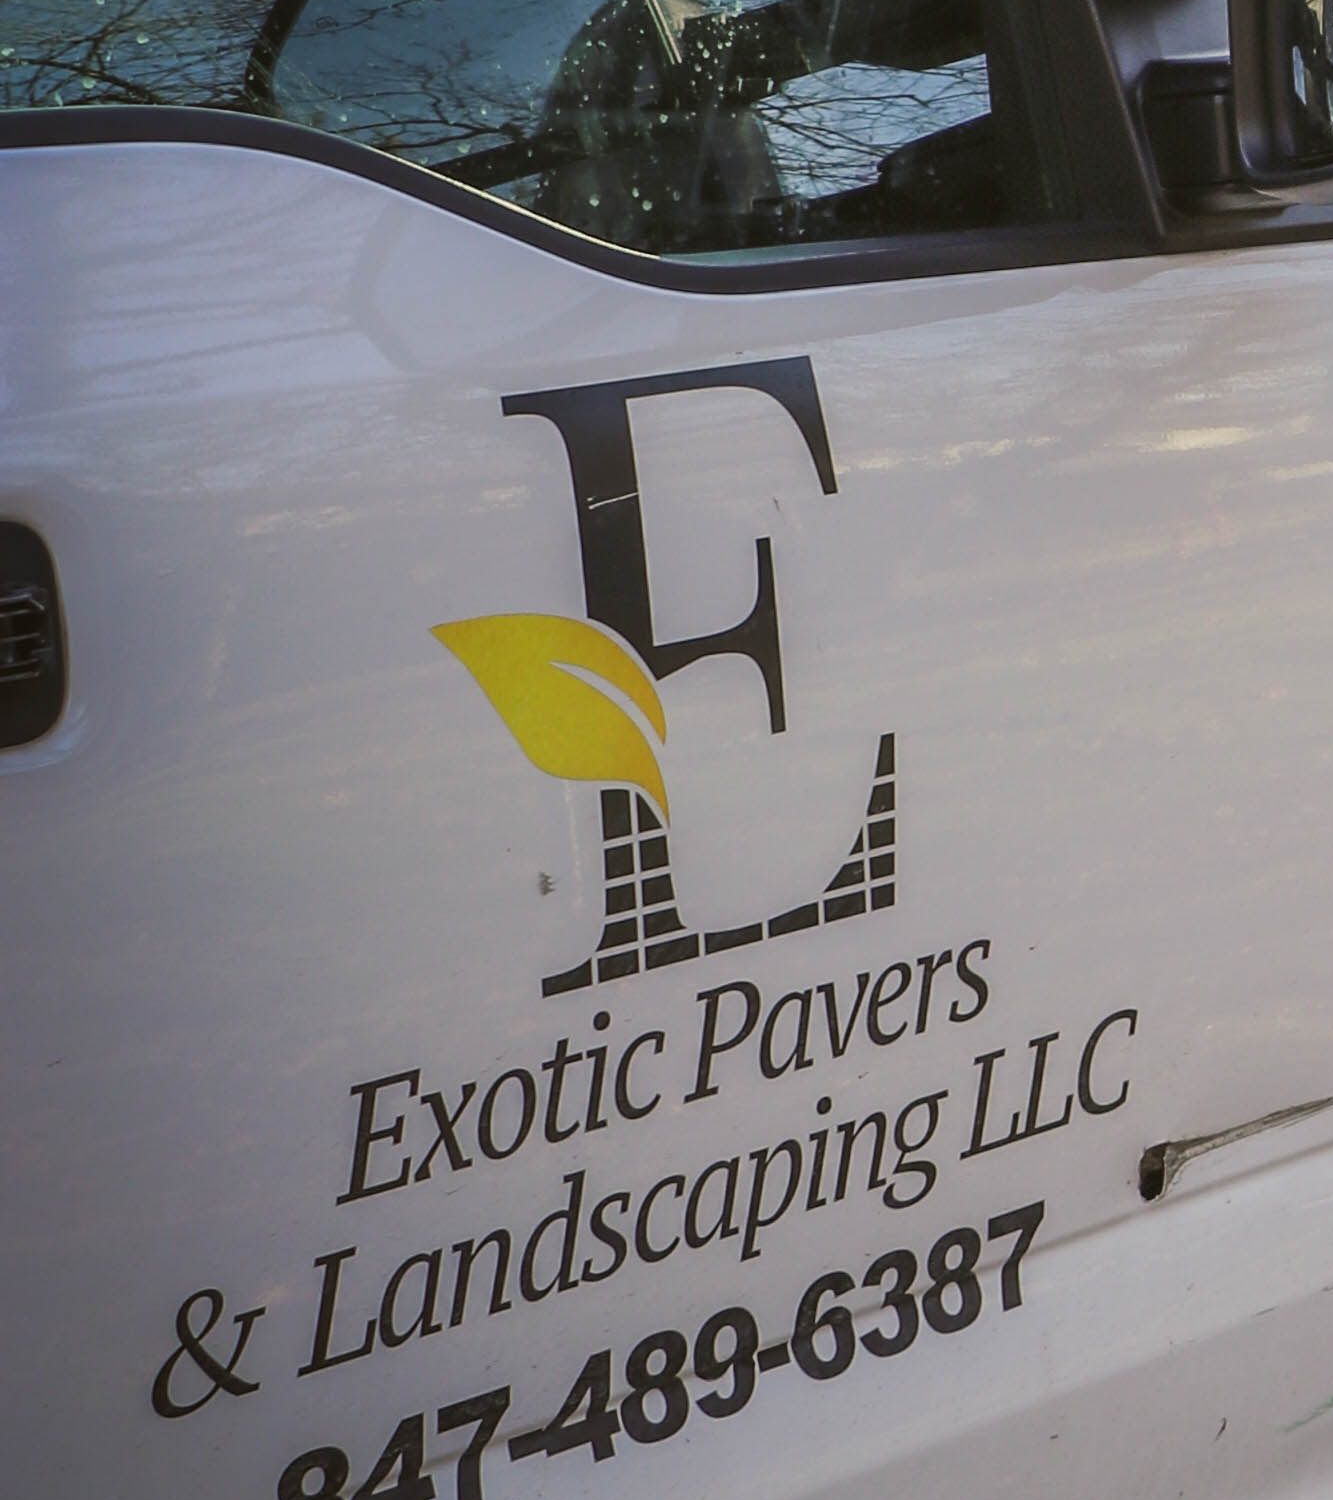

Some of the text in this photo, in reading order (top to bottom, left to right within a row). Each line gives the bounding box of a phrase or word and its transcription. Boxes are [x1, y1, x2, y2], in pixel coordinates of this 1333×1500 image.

[152, 1009, 1139, 1419] & Landscaping LLC
[336, 938, 992, 1206] Exotic Pavers
